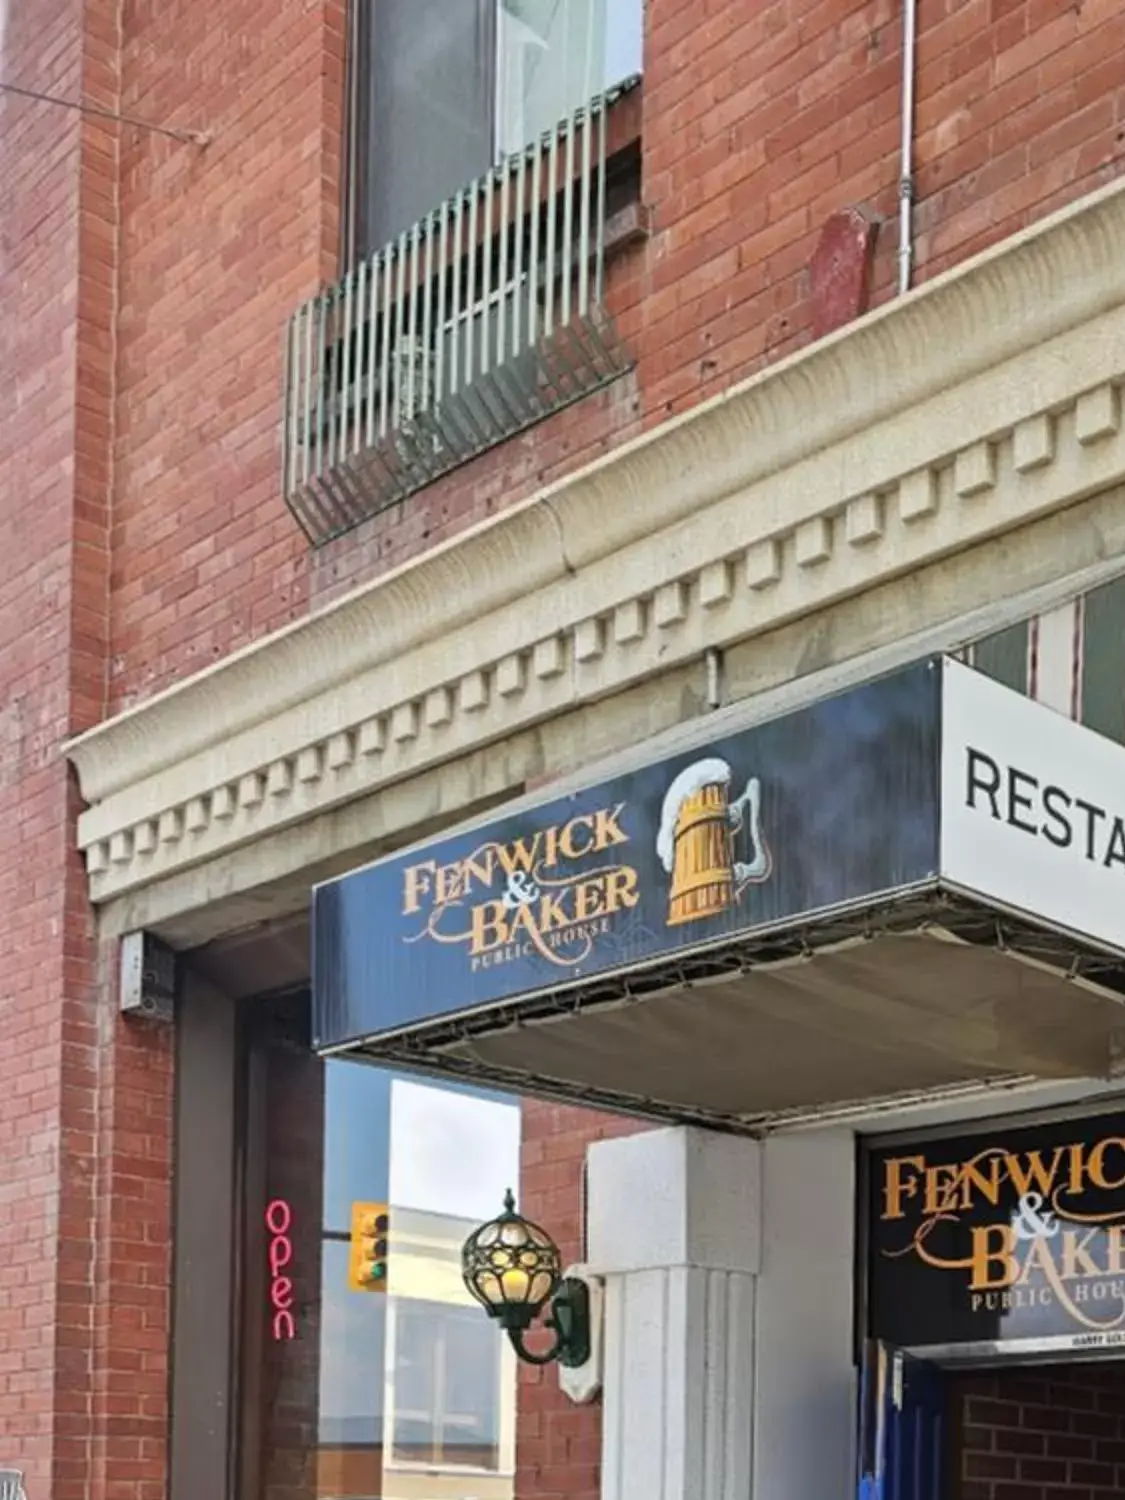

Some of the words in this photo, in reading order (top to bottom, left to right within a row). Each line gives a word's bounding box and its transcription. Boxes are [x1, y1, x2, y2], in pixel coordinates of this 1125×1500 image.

[402, 801, 631, 916] FENWICK
[467, 864, 641, 957] BAKER
[501, 869, 541, 910] &
[470, 942, 537, 973] PUBLIC
[1013, 1191, 1060, 1240] &
[970, 1286, 1053, 1312] PUBLIC
